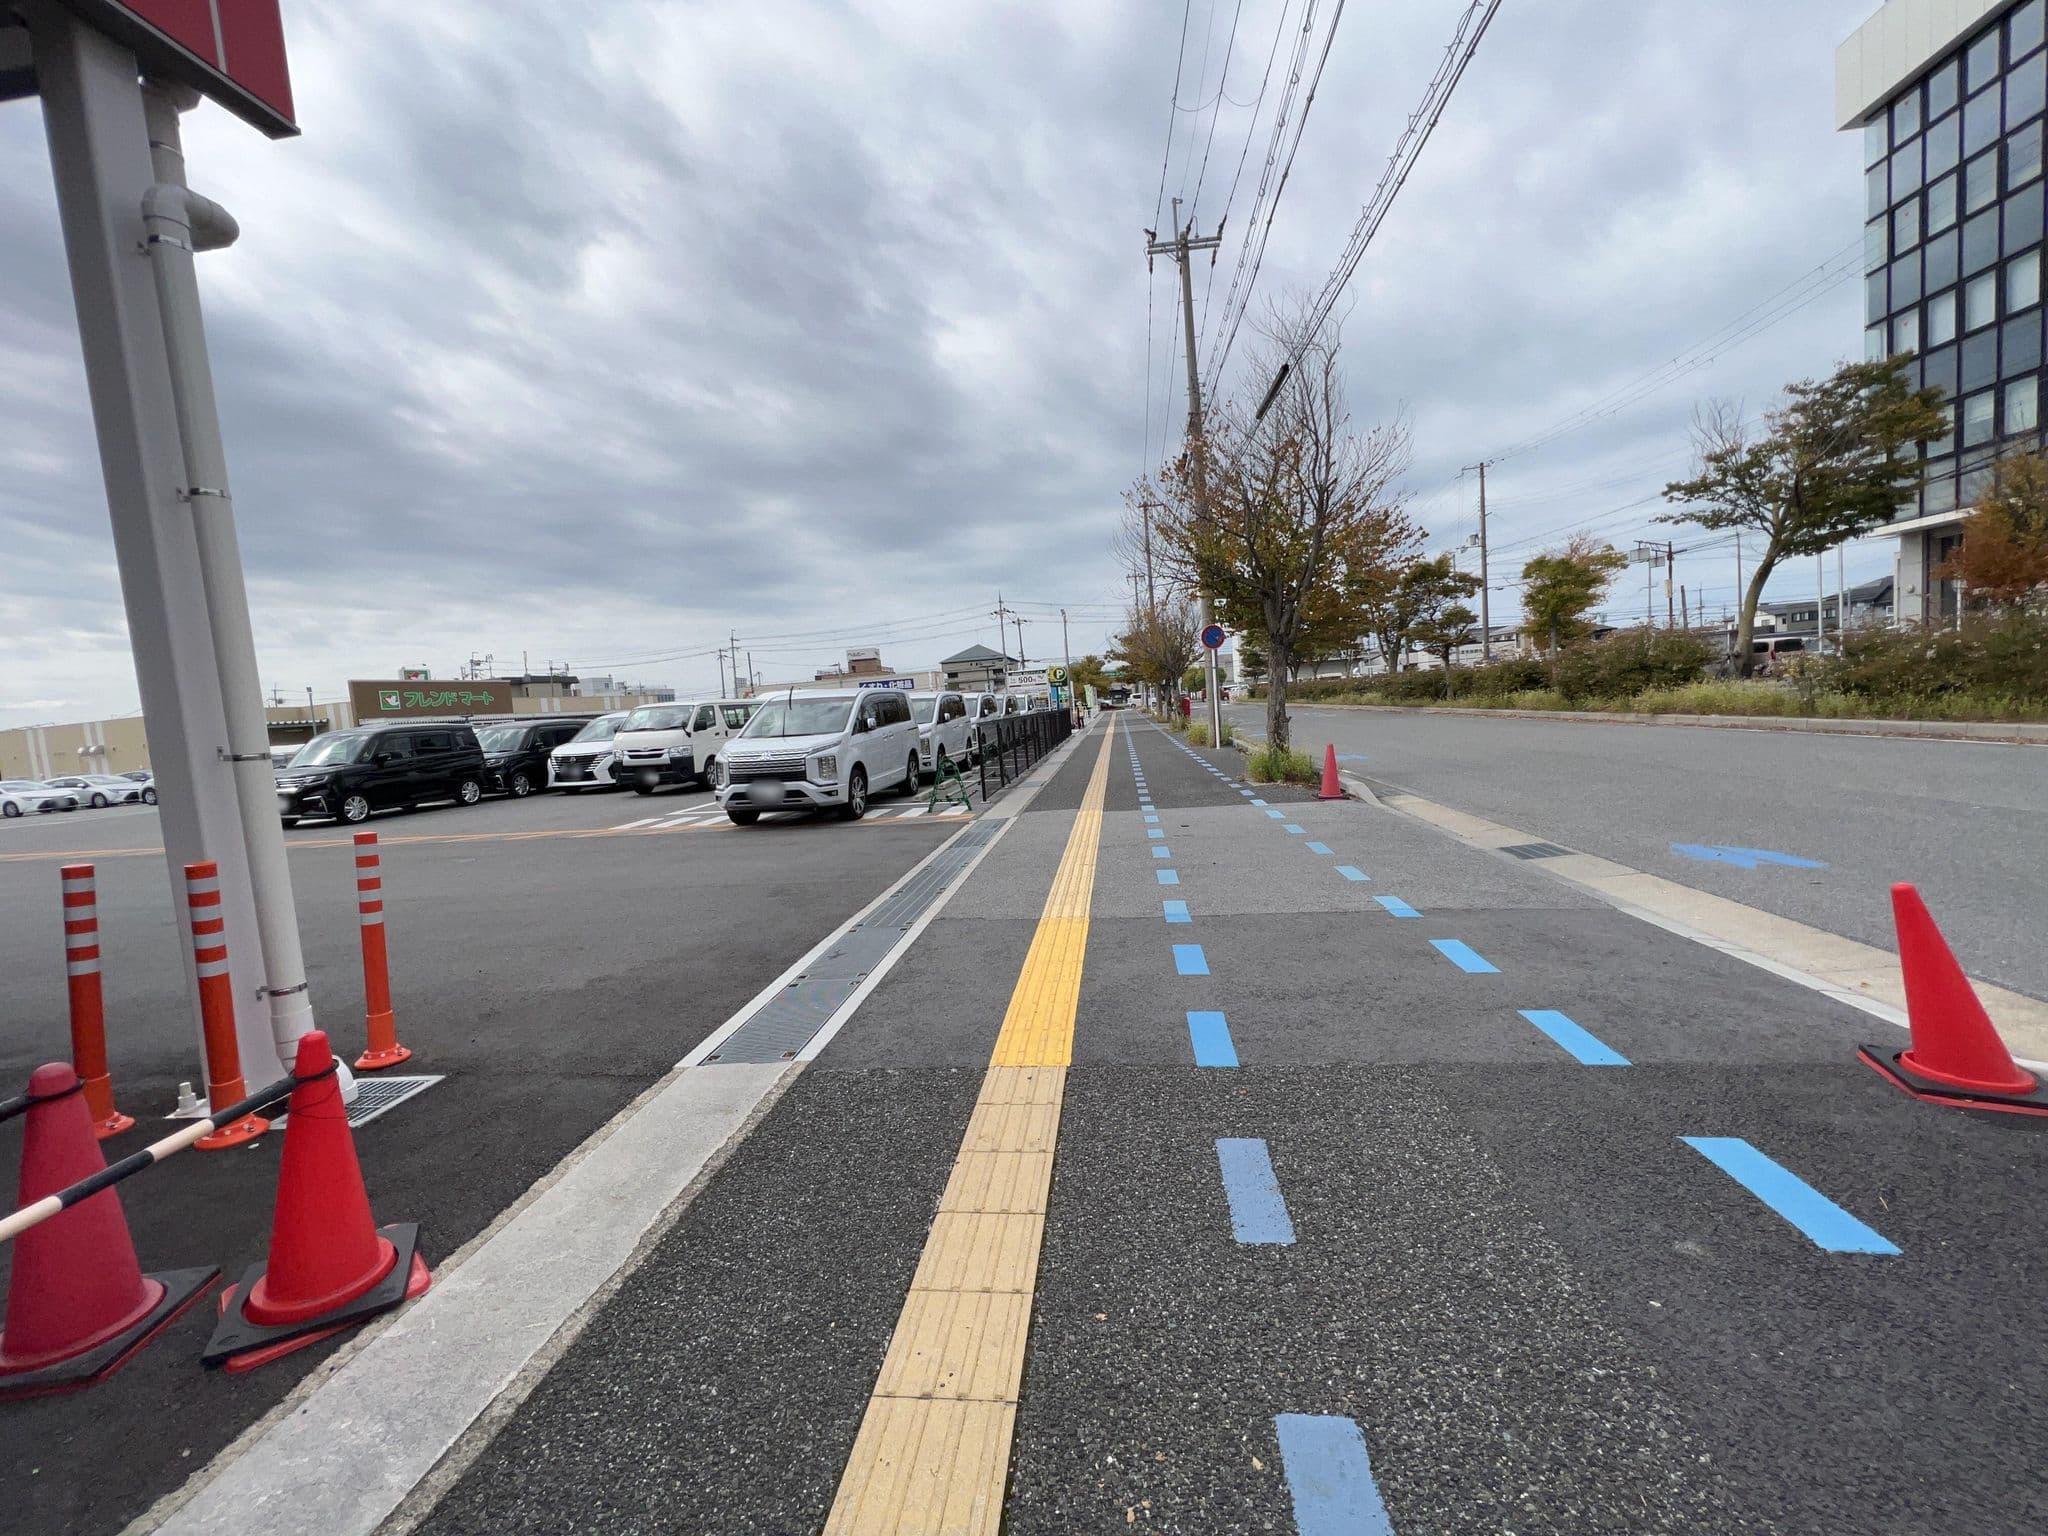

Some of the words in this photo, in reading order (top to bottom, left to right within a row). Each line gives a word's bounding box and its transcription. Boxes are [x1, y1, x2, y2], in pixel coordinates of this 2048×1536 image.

[1056, 669, 1064, 679] P
[1018, 676, 1033, 684] 500
[404, 691, 495, 707] フレンドマート
